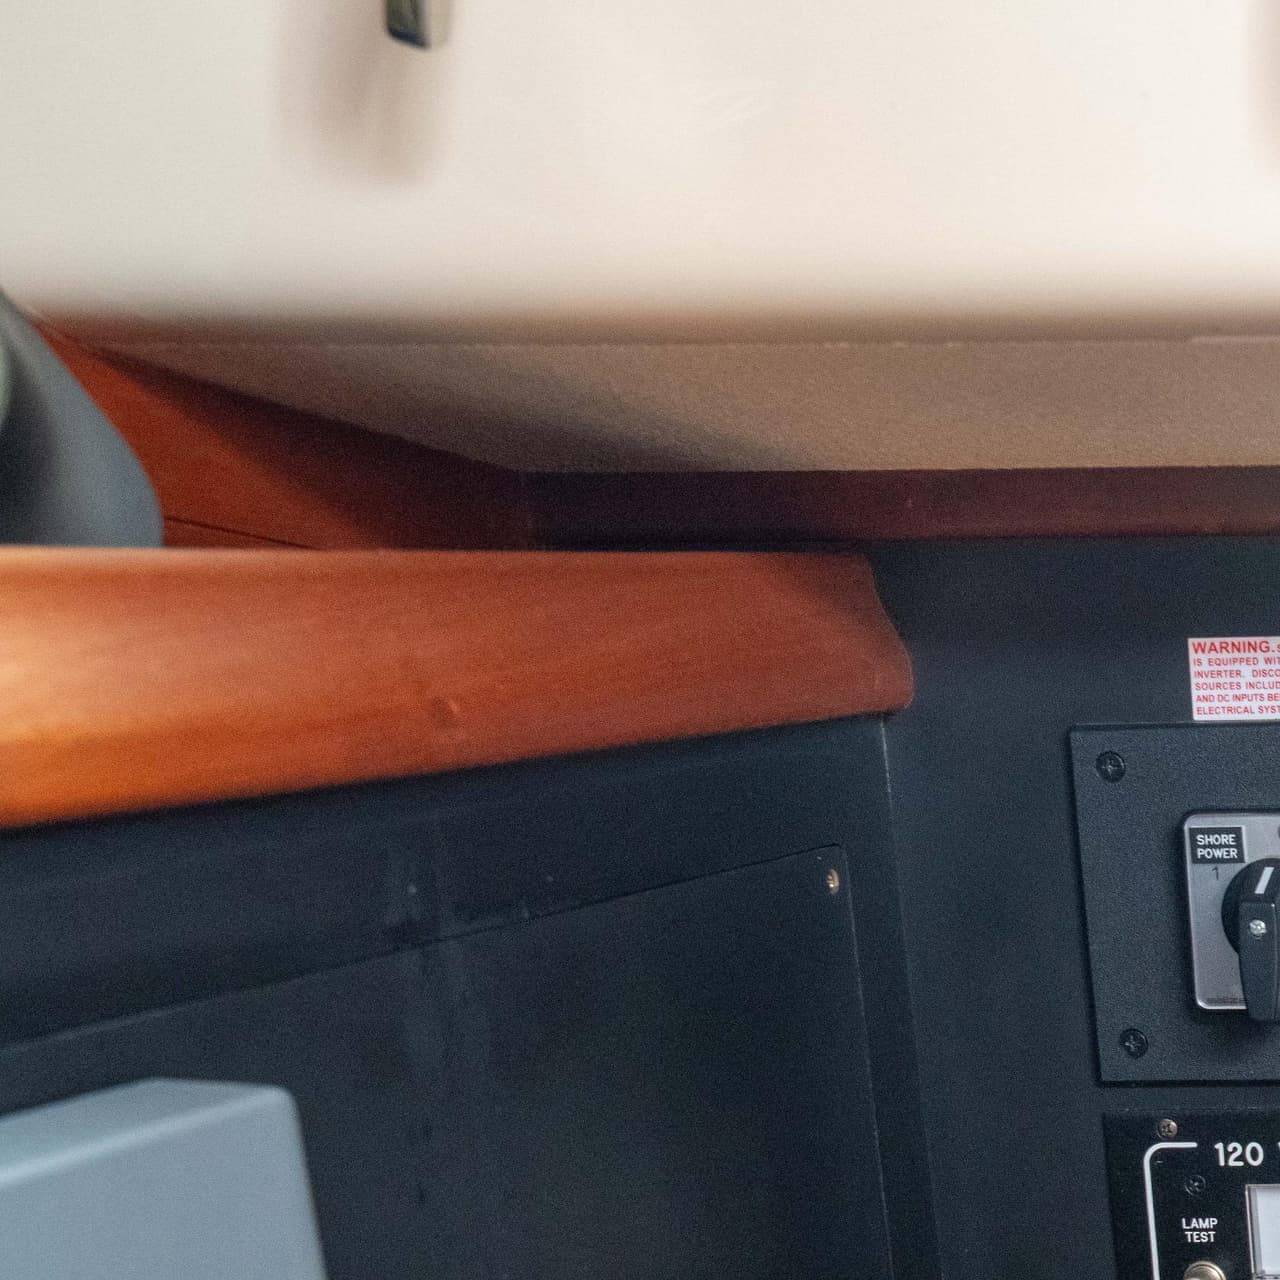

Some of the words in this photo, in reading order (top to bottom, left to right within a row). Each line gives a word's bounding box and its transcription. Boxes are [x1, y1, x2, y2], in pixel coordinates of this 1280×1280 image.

[1192, 640, 1274, 653] WARNING.
[1194, 670, 1245, 678] INVERTER.
[1196, 694, 1215, 702] AND
[1218, 694, 1230, 702] DC
[1233, 694, 1265, 702] INPUTS
[1197, 834, 1236, 846] SHORE
[1197, 847, 1237, 859] POWER
[1215, 1143, 1264, 1166] 120
[1182, 1219, 1218, 1229] LAMP
[1185, 1232, 1215, 1242] TEST
